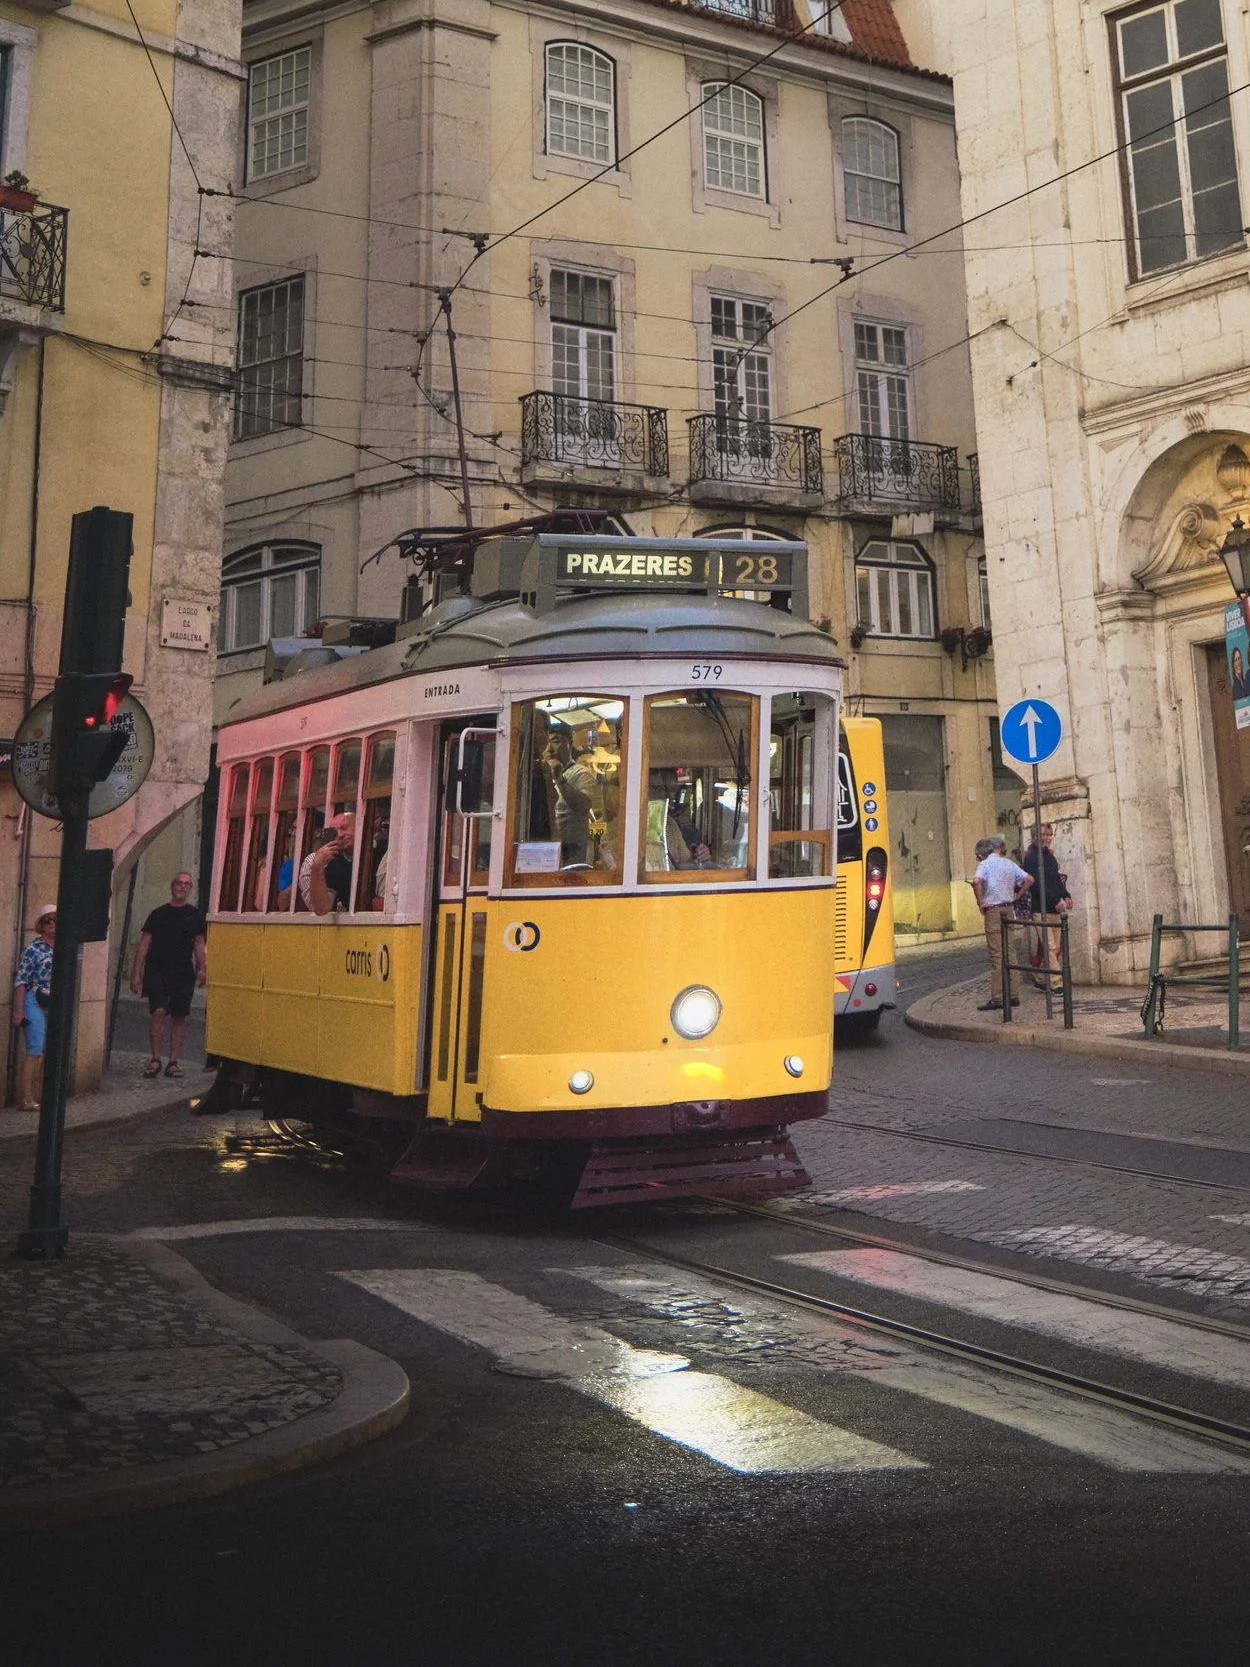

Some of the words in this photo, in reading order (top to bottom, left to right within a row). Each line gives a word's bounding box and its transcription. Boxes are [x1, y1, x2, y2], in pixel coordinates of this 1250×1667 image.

[566, 553, 693, 576] PRAZERES
[734, 555, 779, 584] 28
[691, 665, 723, 680] 579
[424, 684, 460, 698] ENTRADA
[345, 941, 372, 977] carris
